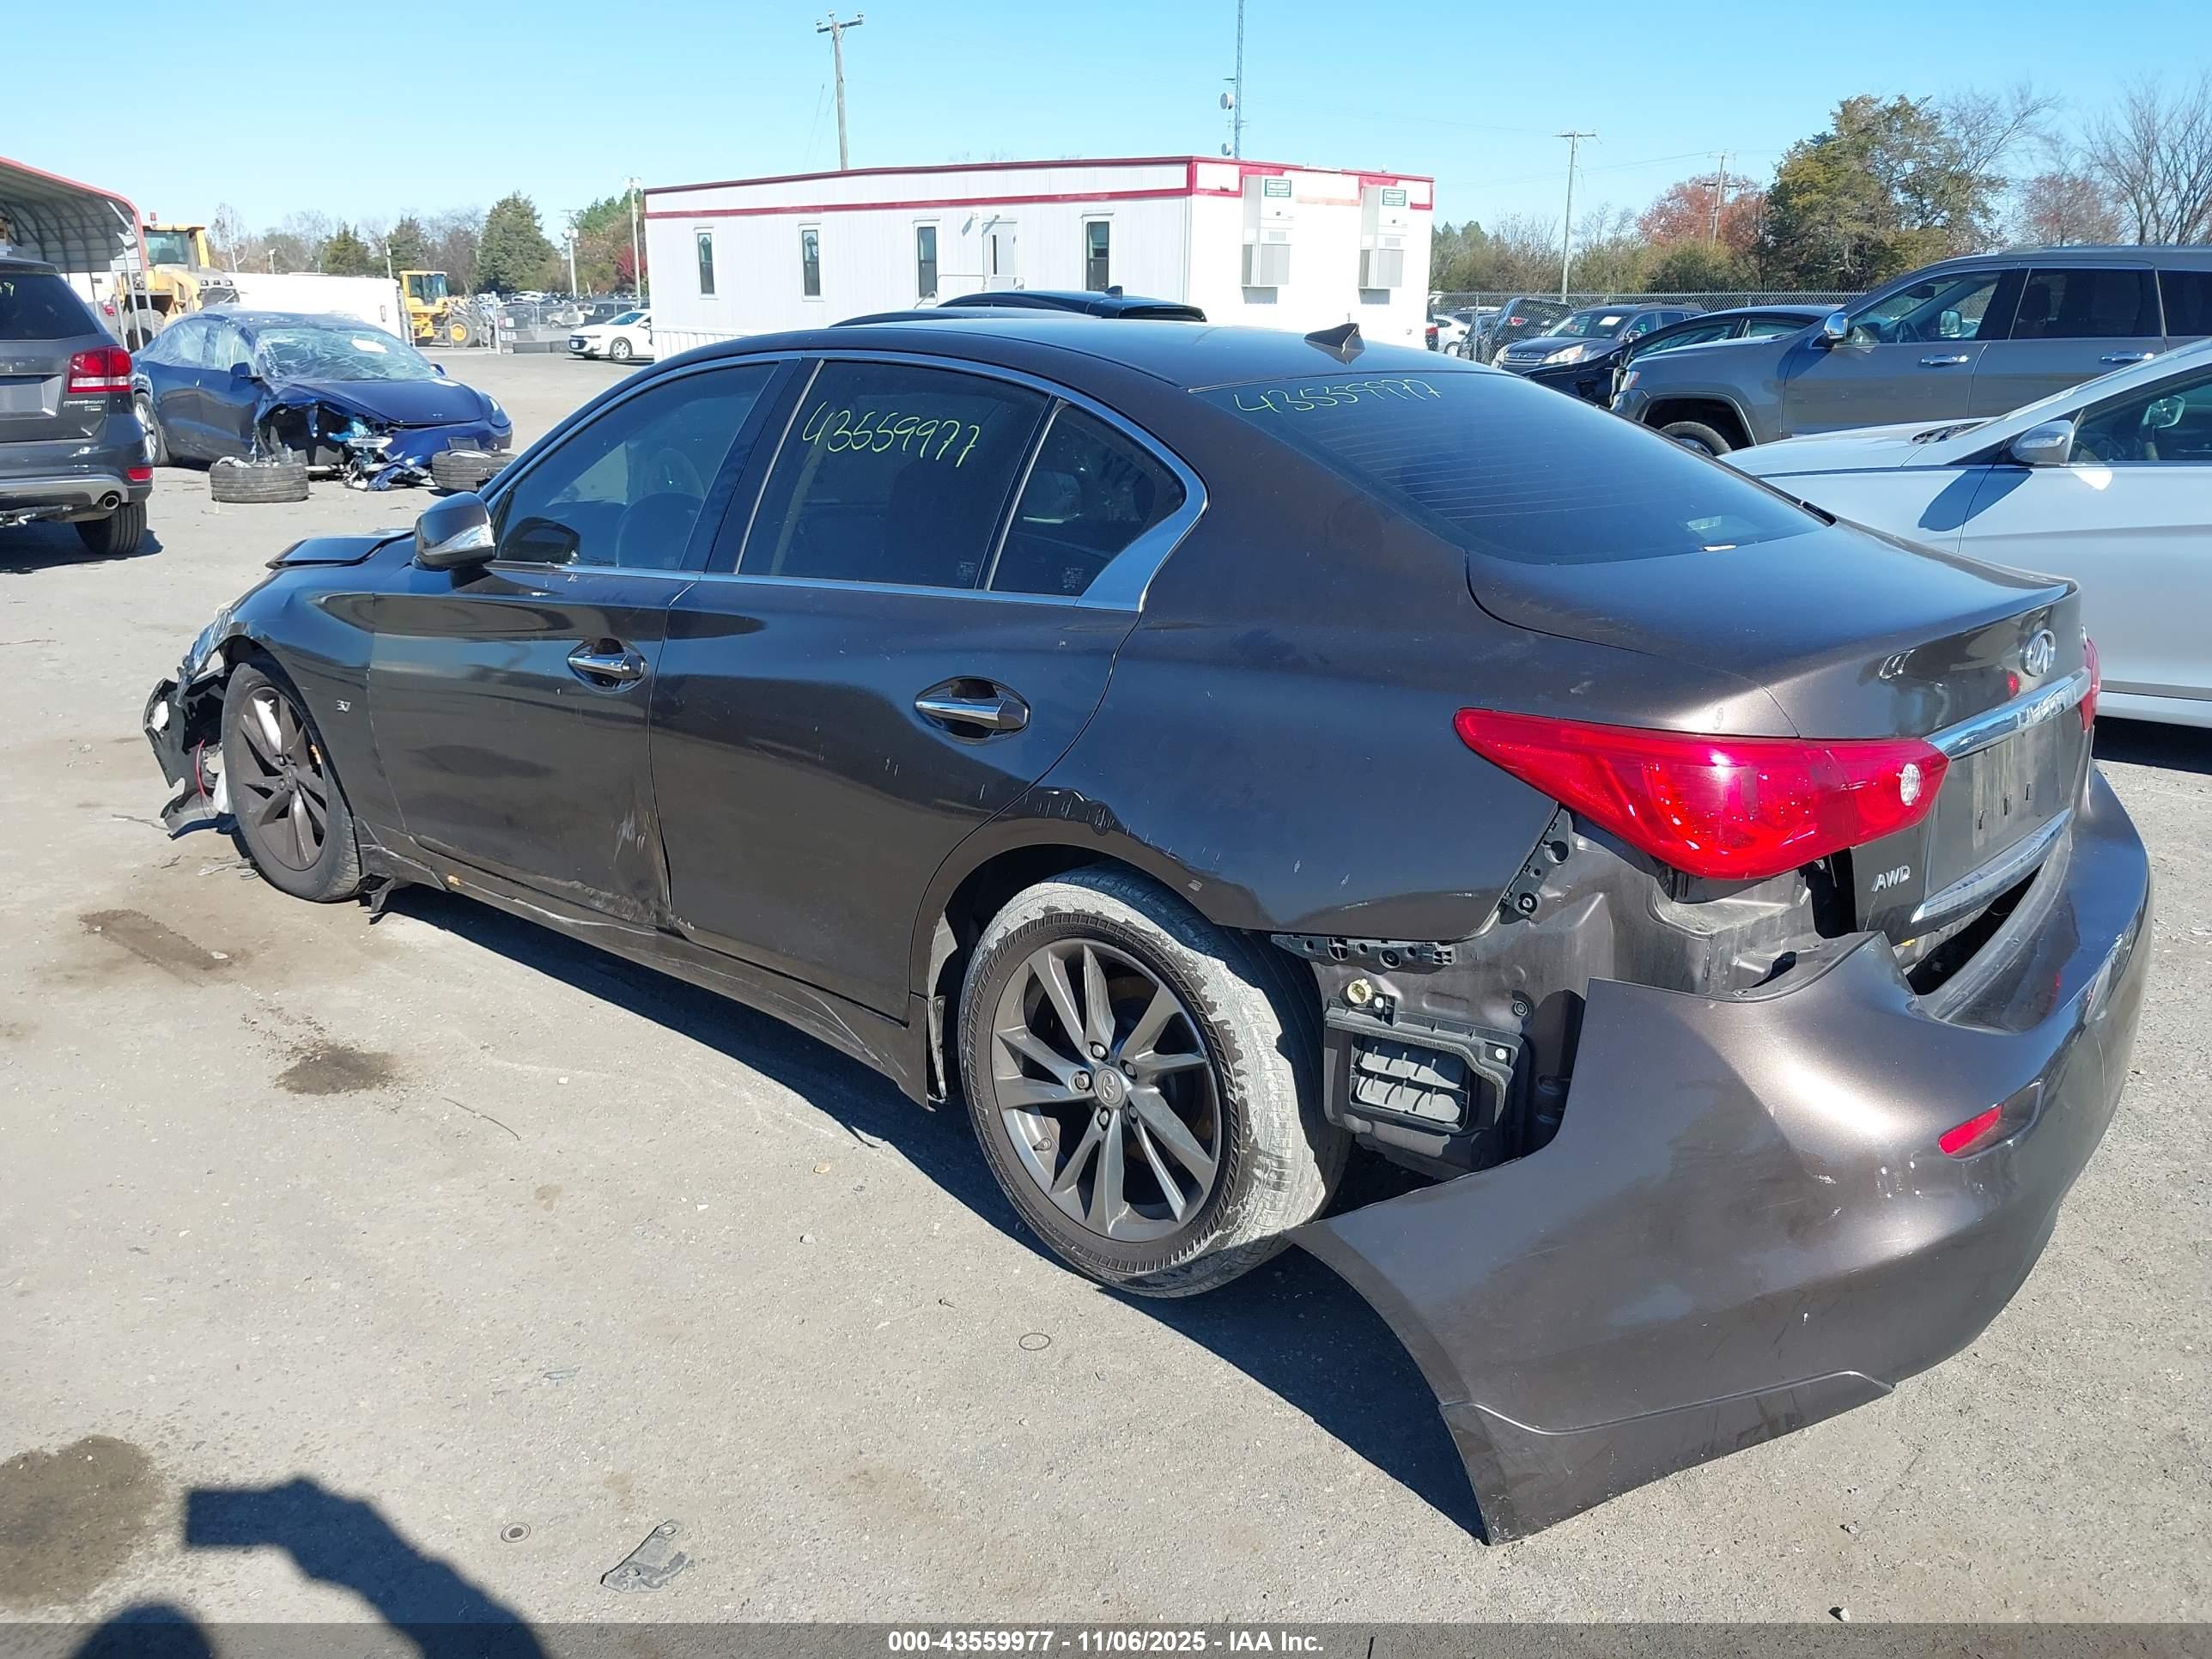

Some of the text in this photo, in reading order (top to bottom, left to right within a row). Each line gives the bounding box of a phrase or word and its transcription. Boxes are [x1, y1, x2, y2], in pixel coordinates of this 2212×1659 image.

[1233, 379, 1443, 413] 43559977
[802, 400, 981, 468] 43559977
[1870, 865, 1911, 892] AWD
